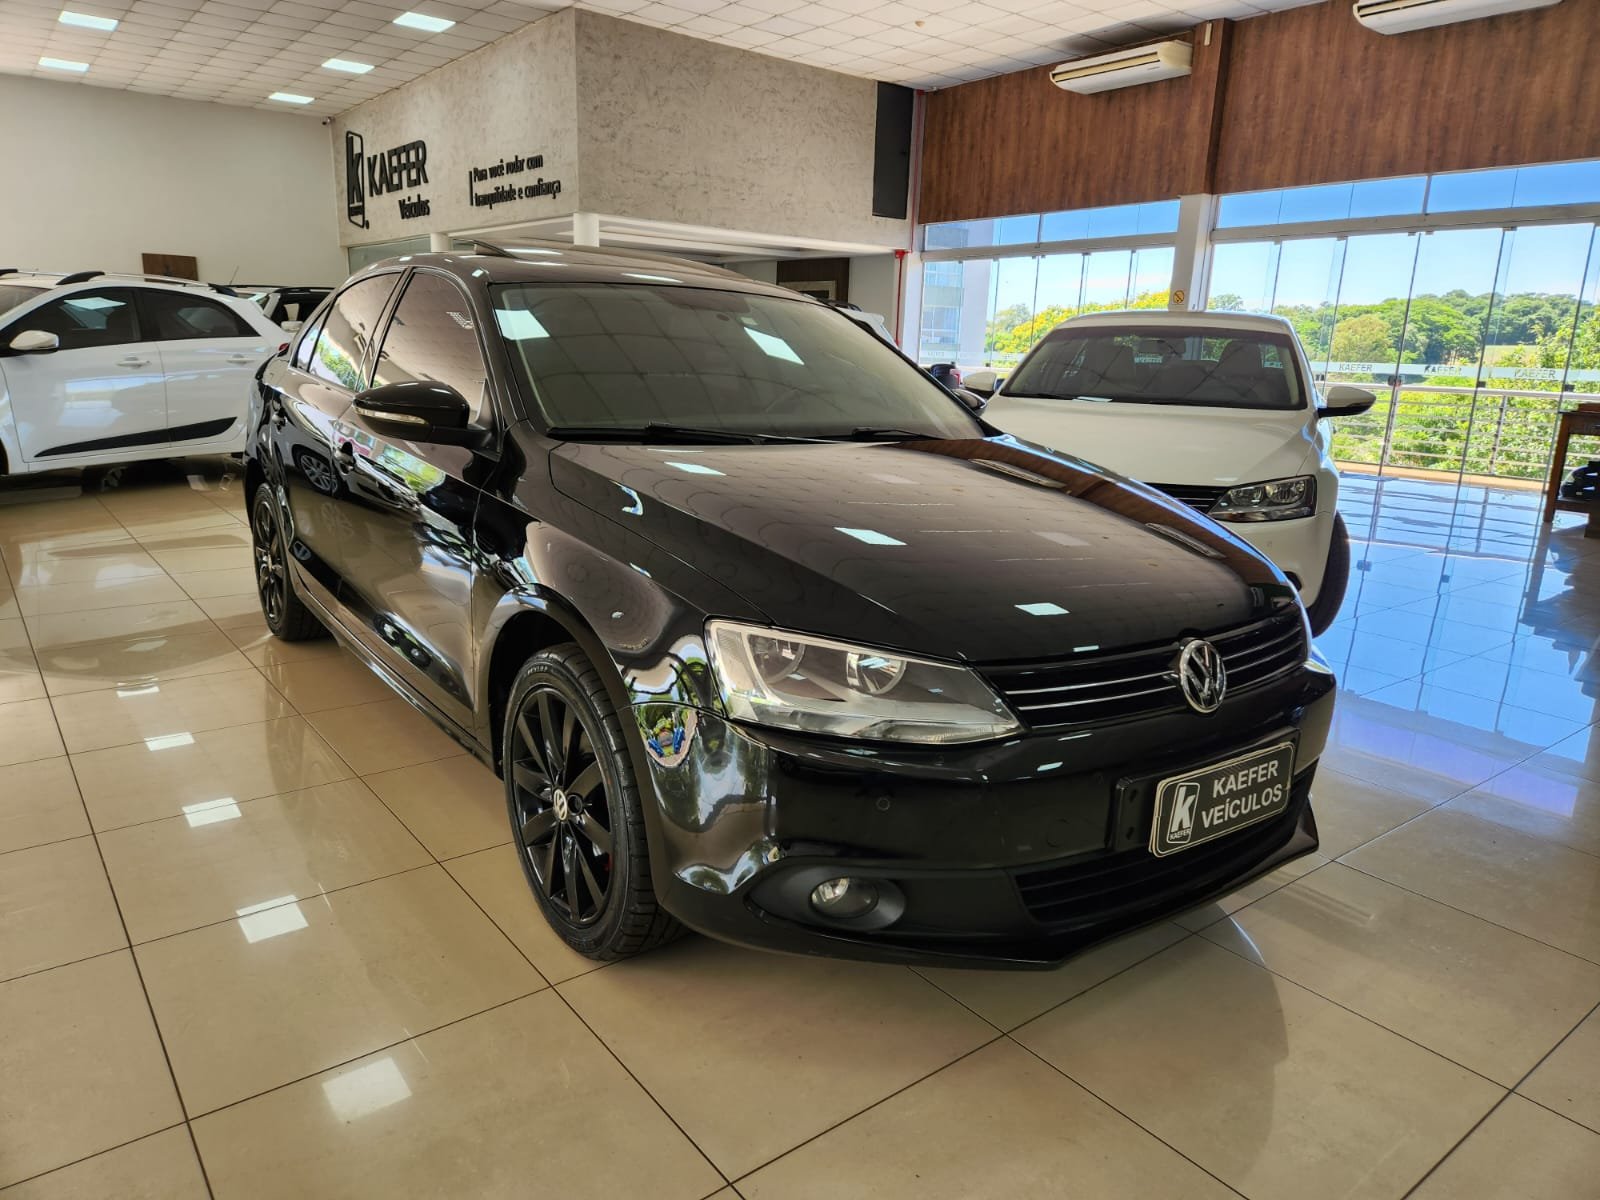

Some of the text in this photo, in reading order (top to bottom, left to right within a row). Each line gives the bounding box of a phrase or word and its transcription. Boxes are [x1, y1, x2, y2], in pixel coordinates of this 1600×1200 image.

[367, 140, 429, 197] KAEFER
[526, 154, 543, 170] com
[518, 187, 524, 200] e
[1339, 364, 1373, 372] KAEFER
[1212, 760, 1279, 798] KAEFER
[1201, 783, 1283, 829] VEÍCULOS
[1169, 829, 1191, 841] KAEFER
